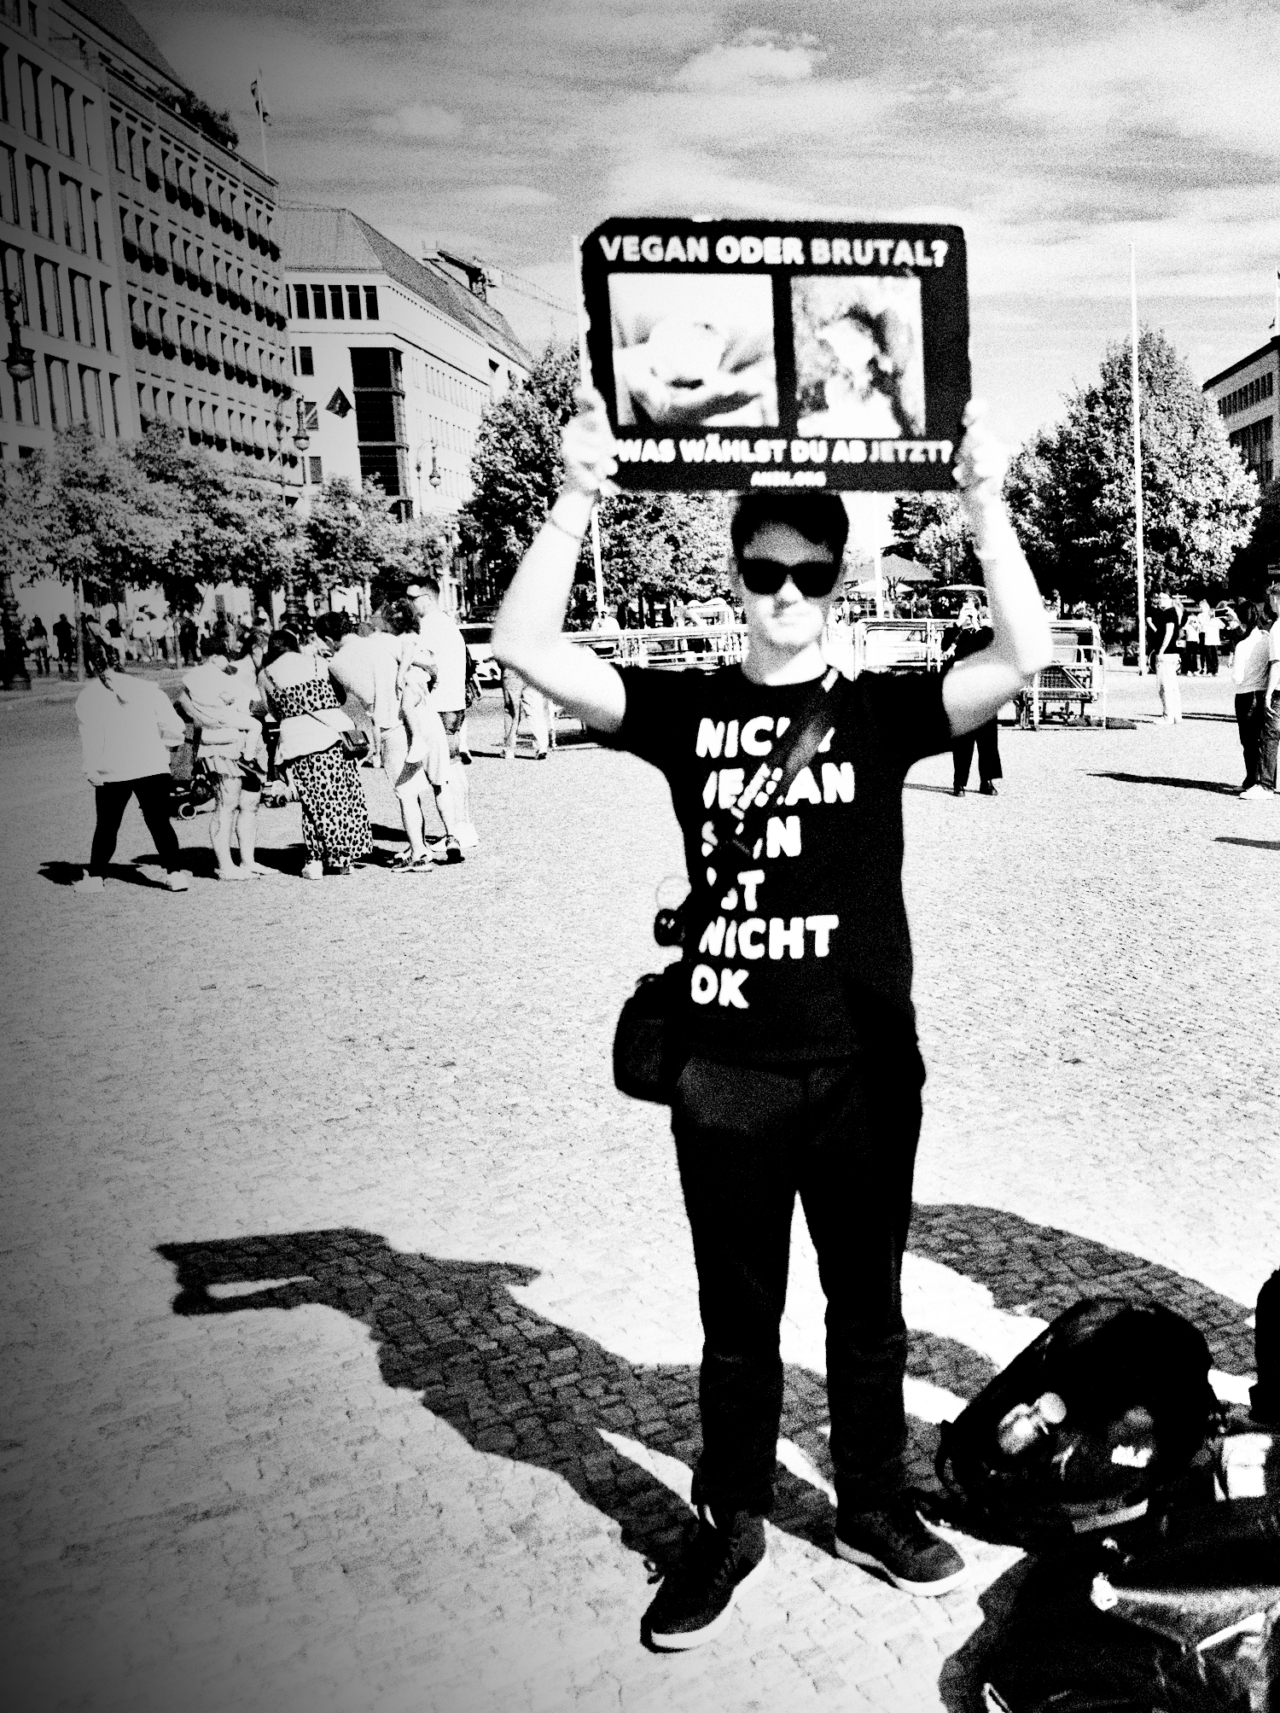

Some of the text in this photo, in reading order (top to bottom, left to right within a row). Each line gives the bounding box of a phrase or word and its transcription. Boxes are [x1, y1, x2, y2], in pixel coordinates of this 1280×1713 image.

[599, 234, 949, 267] VEGAN ODER BRUTAL?
[616, 438, 676, 463] WAS
[680, 433, 787, 463] WÄHLST
[791, 439, 828, 463] DU
[831, 439, 867, 463] AB
[699, 914, 840, 961] NICHT
[691, 963, 750, 1009] OK
